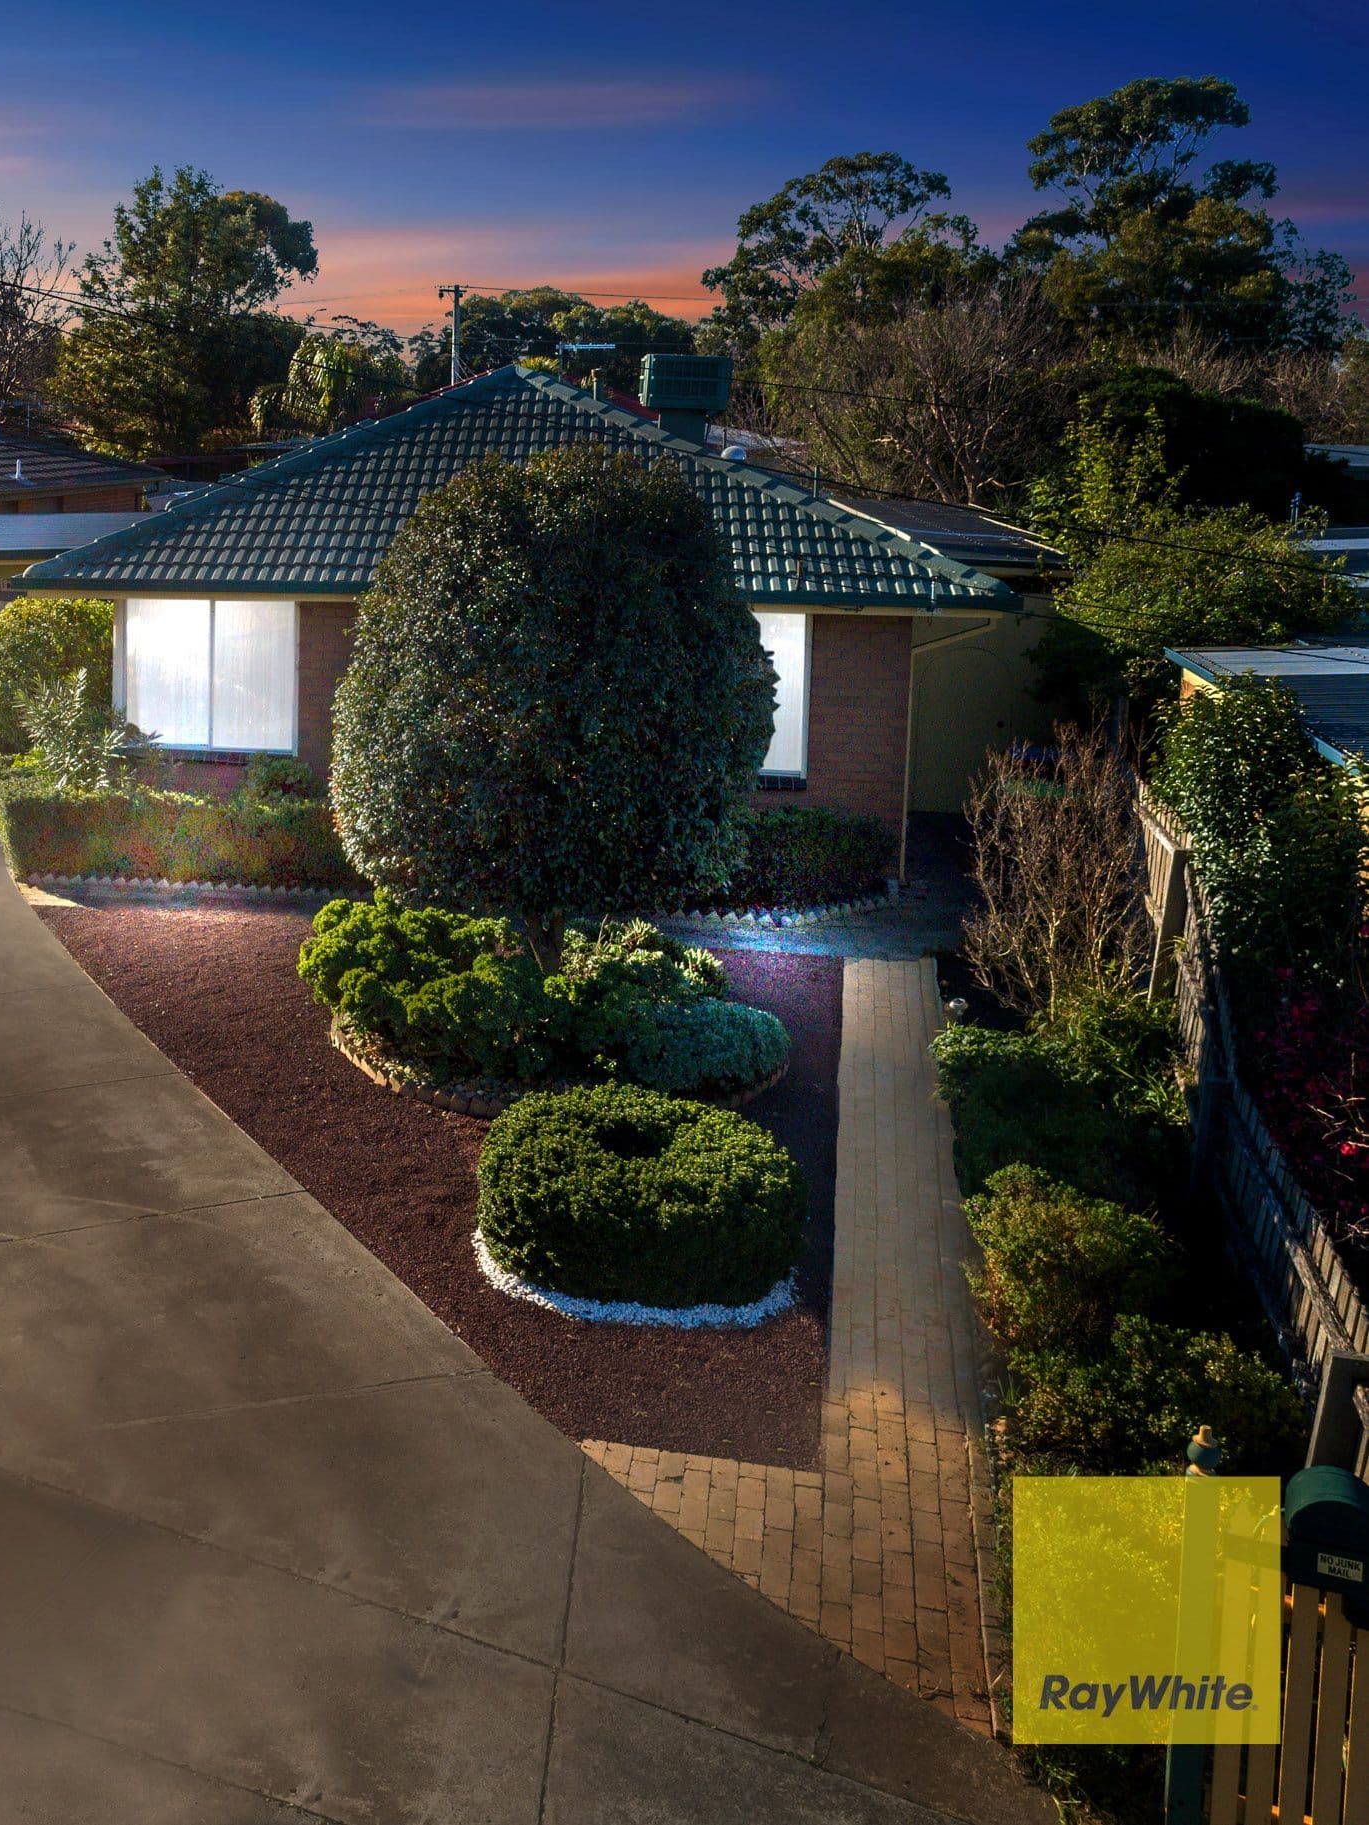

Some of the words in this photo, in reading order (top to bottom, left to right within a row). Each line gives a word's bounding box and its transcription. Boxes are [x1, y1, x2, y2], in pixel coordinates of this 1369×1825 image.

[1320, 1555, 1333, 1564] NO
[1335, 1558, 1361, 1571] JUNK
[1328, 1566, 1351, 1577] MAIL
